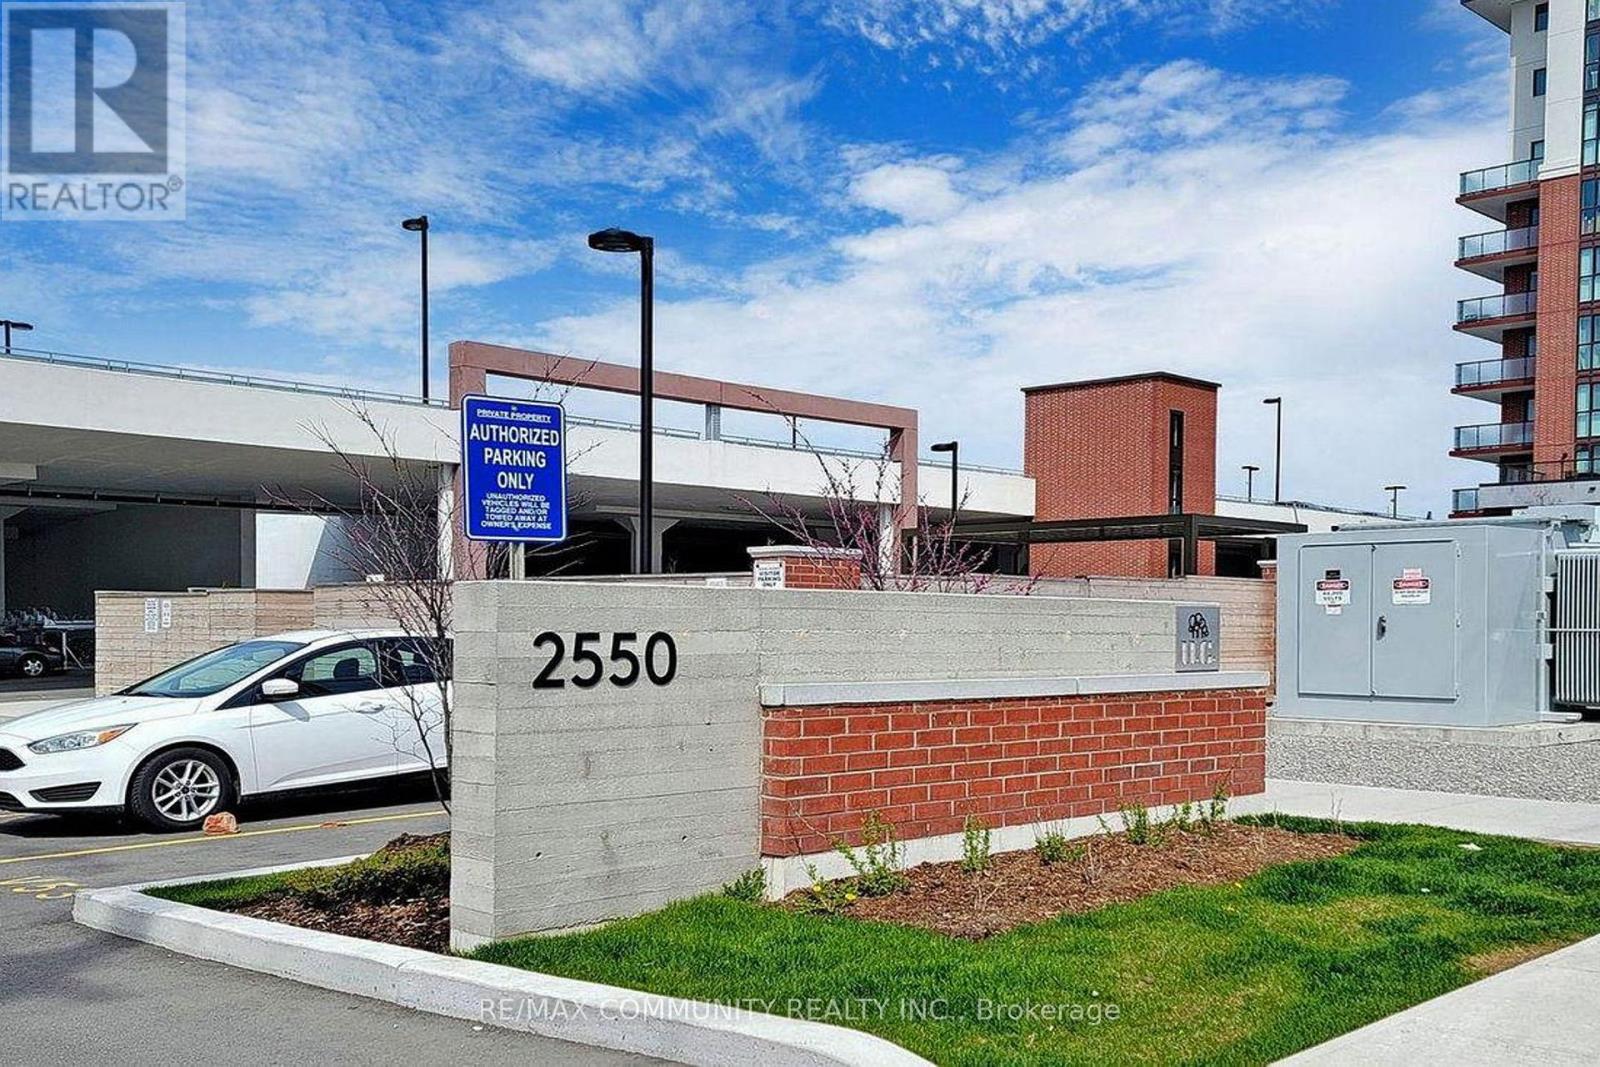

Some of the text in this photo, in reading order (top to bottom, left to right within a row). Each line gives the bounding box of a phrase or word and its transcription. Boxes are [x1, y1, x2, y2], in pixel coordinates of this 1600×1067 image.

[477, 408, 552, 423] PRIVATE PROPERTY
[469, 423, 560, 446] AUTHORIZED
[484, 447, 546, 468] PARKING
[497, 471, 534, 490] ONLY
[486, 493, 546, 502] UNAUTHORIZED
[481, 499, 519, 508] VEHICLES
[521, 501, 540, 509] WILL
[485, 506, 548, 516] TAGGED AND/OR
[485, 513, 512, 521] TOWED
[517, 521, 552, 530] EXPENSE
[532, 631, 678, 689] 2550
